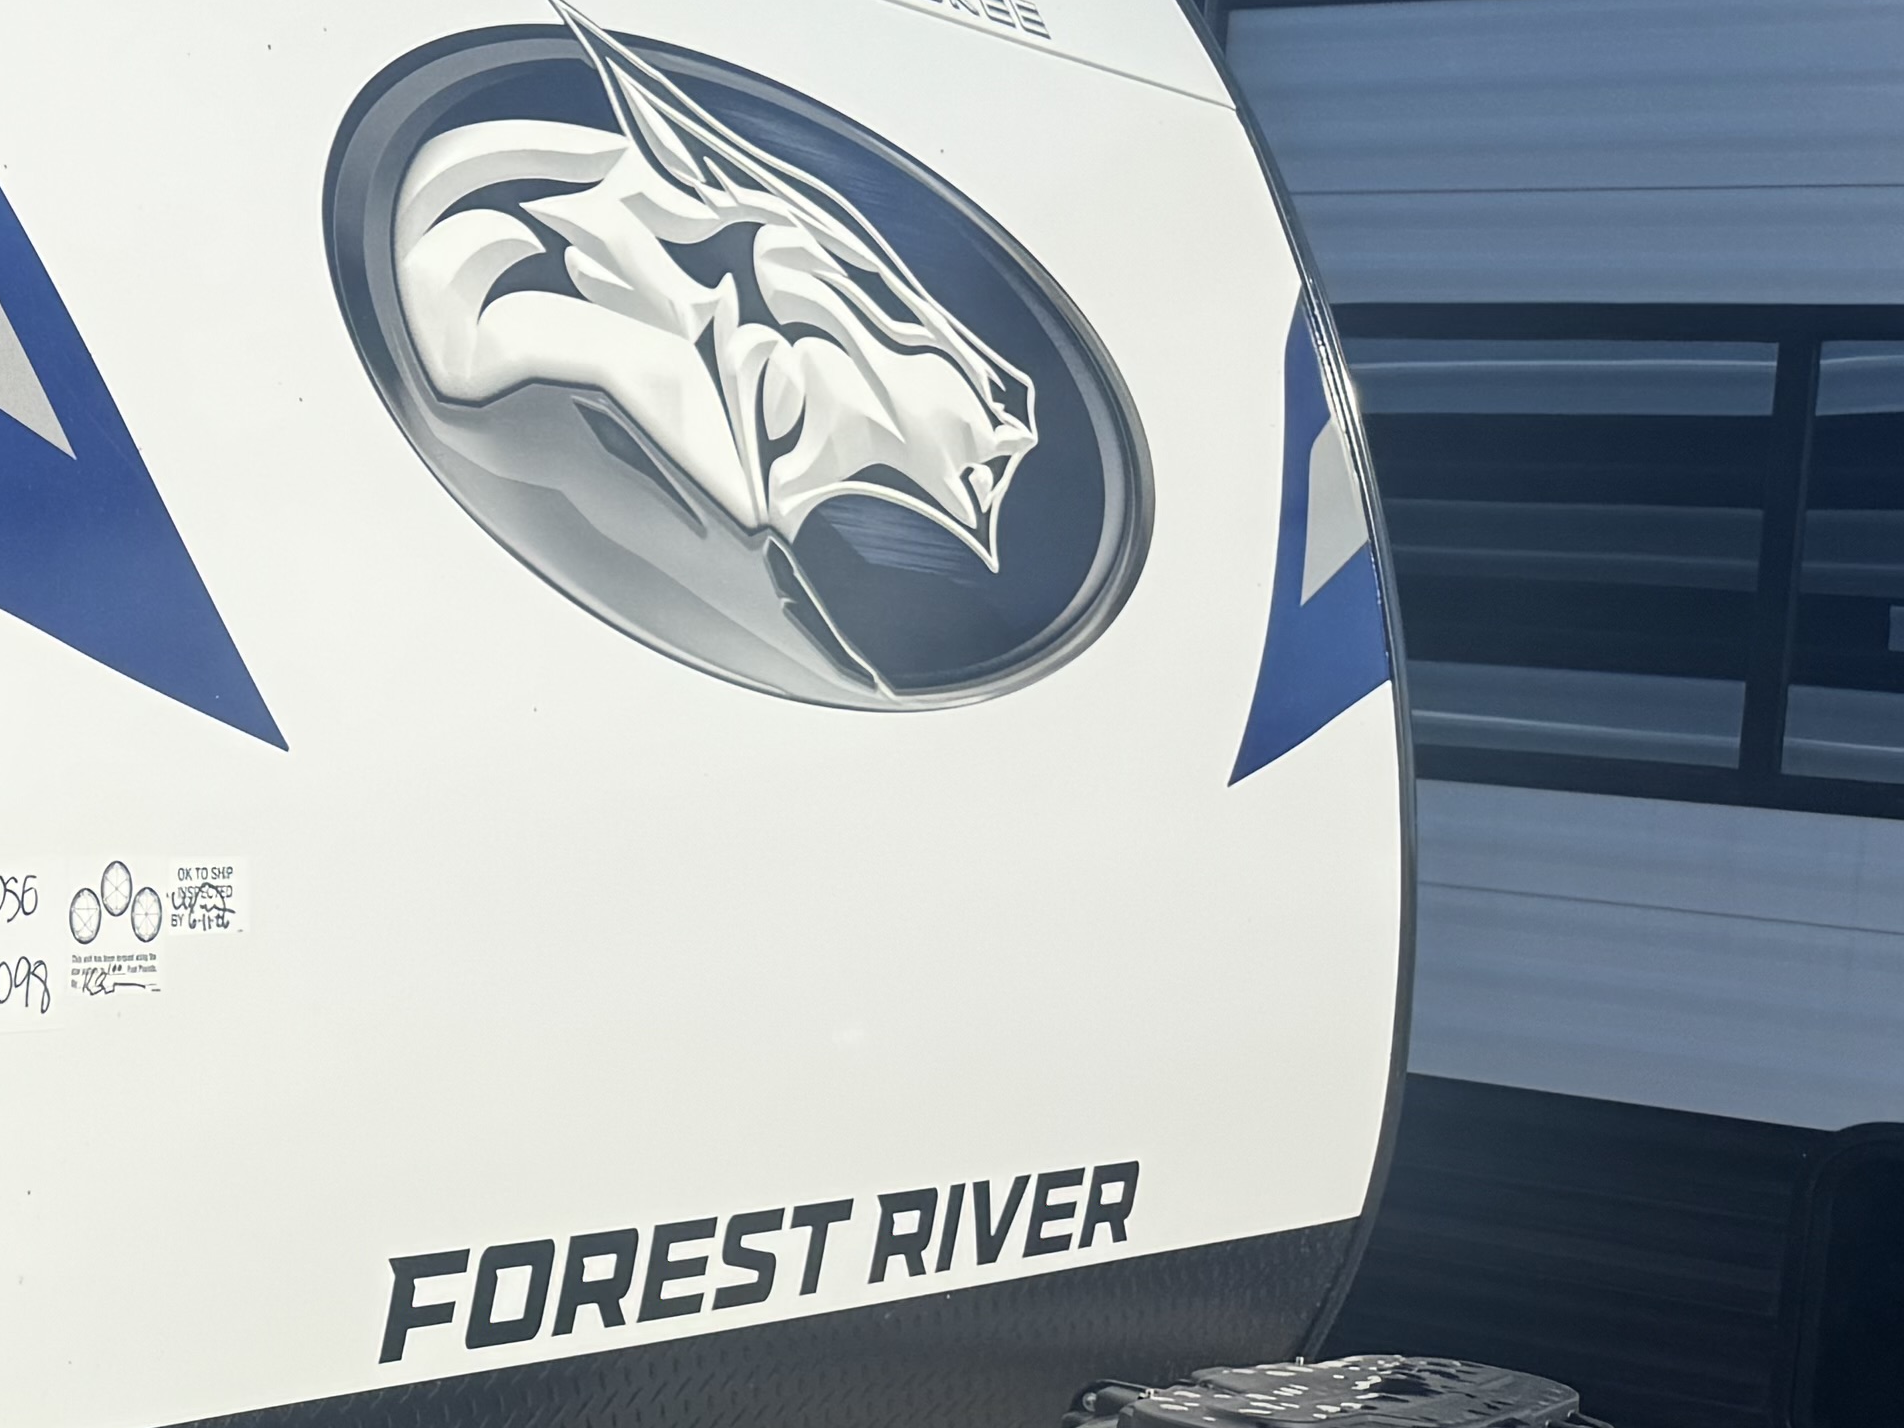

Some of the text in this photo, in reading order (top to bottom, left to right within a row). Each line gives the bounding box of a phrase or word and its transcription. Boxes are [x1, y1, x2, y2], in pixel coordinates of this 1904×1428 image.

[178, 866, 233, 881] OK TO SHIP
[171, 913, 184, 927] BY
[378, 1160, 1139, 1364] FOREST RIVER
